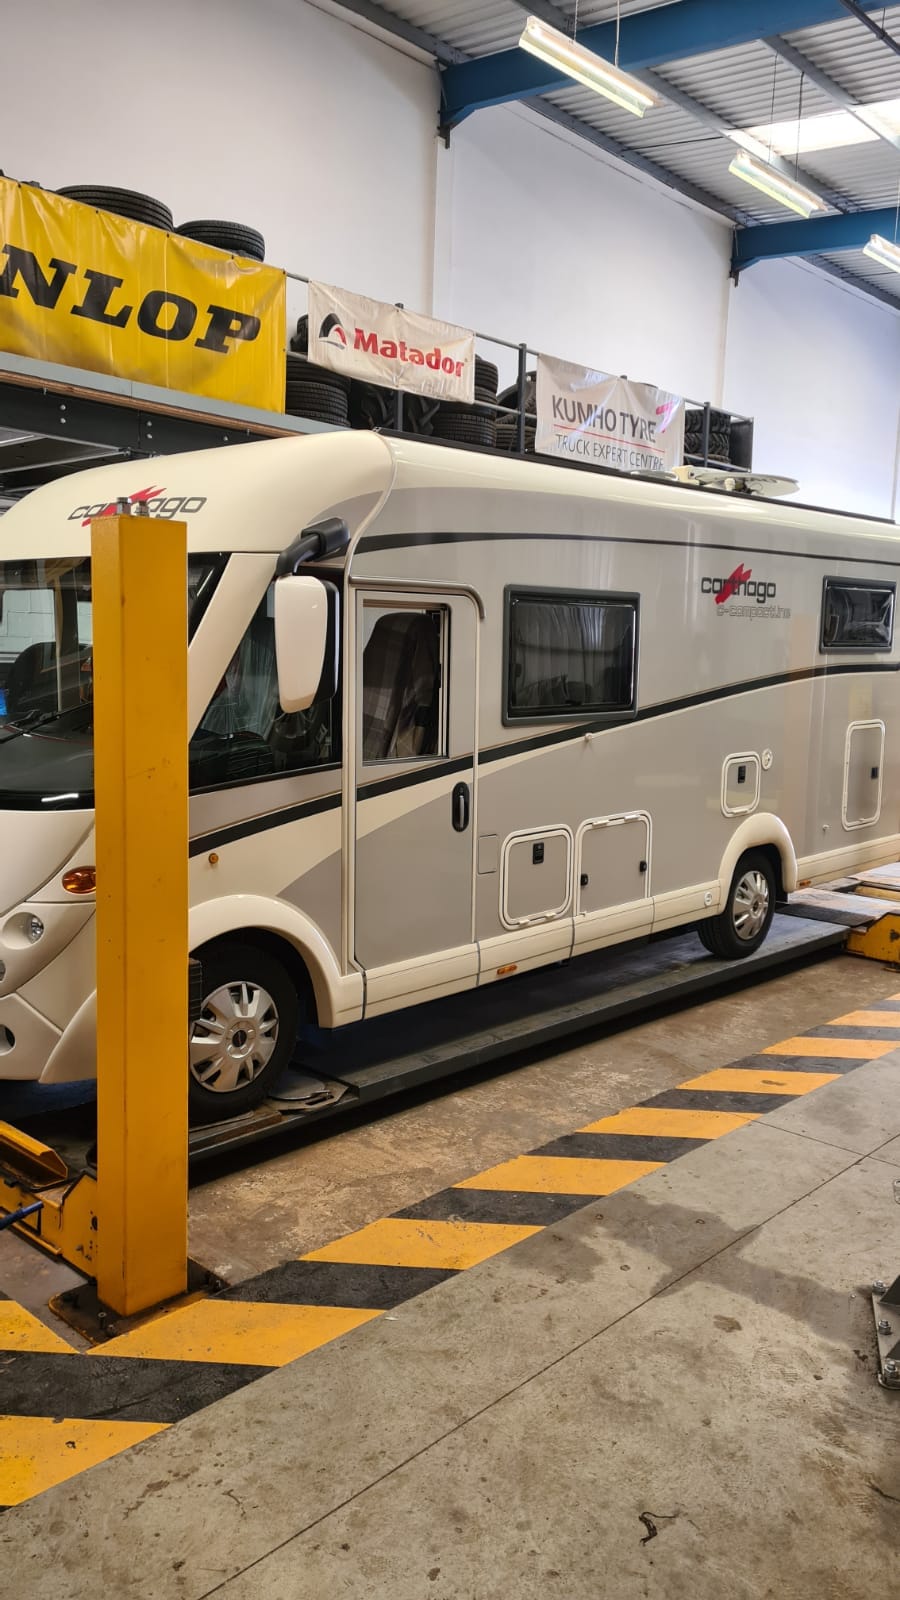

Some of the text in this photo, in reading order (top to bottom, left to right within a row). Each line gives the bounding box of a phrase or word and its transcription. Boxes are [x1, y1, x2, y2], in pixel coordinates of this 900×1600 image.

[354, 328, 465, 377] Matador
[552, 395, 656, 443] KUMHO TYRE
[555, 433, 591, 457] TRUCK
[593, 442, 628, 465] EXPERT
